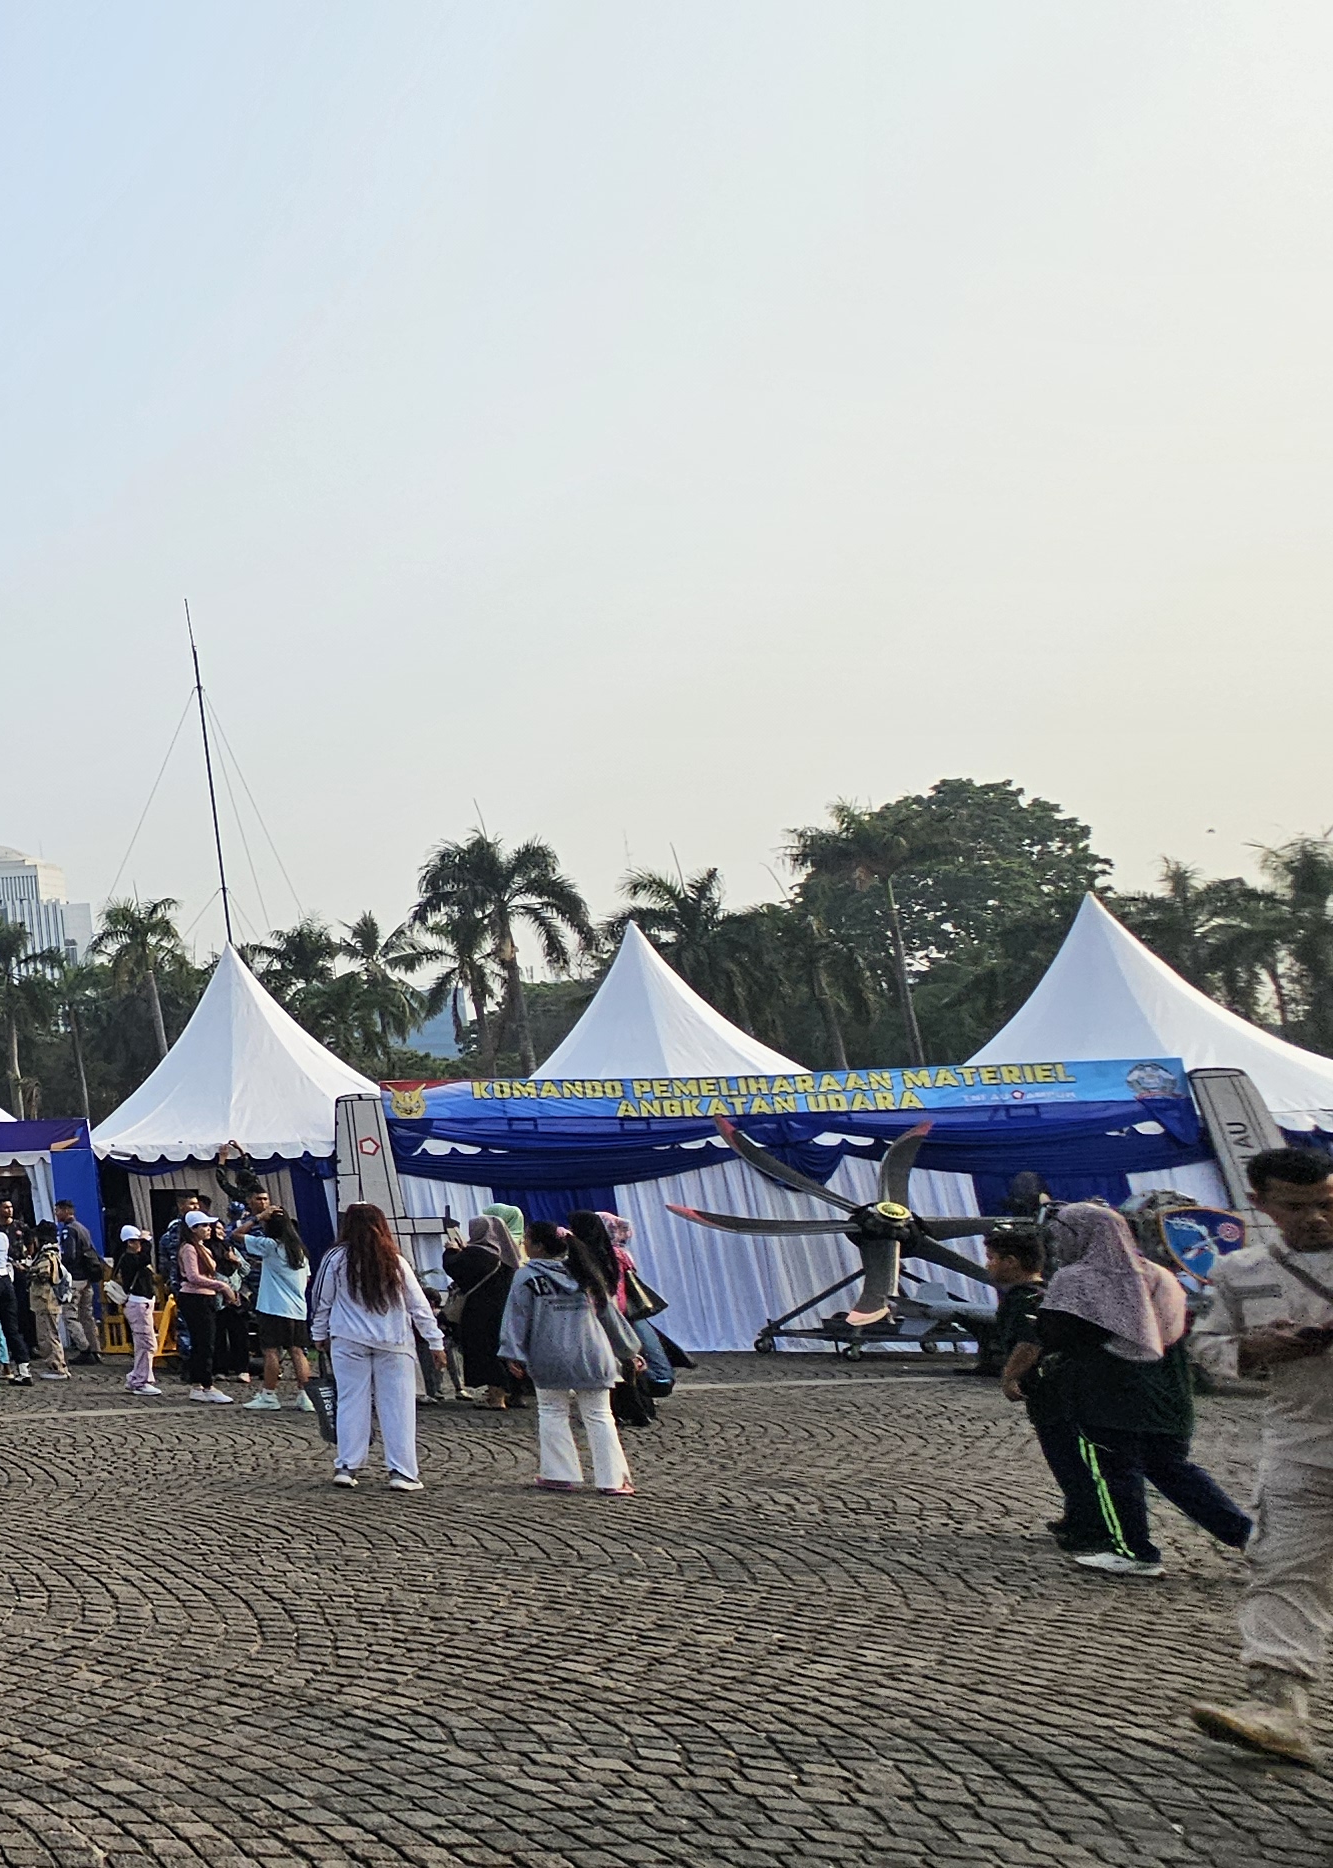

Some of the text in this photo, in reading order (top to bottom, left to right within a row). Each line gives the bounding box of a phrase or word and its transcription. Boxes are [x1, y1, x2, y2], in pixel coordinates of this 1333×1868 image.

[471, 1063, 1077, 1100] KOMANDO PEMELIHARAAN MATERIEL
[616, 1090, 927, 1118] ANGKATAN UDARA
